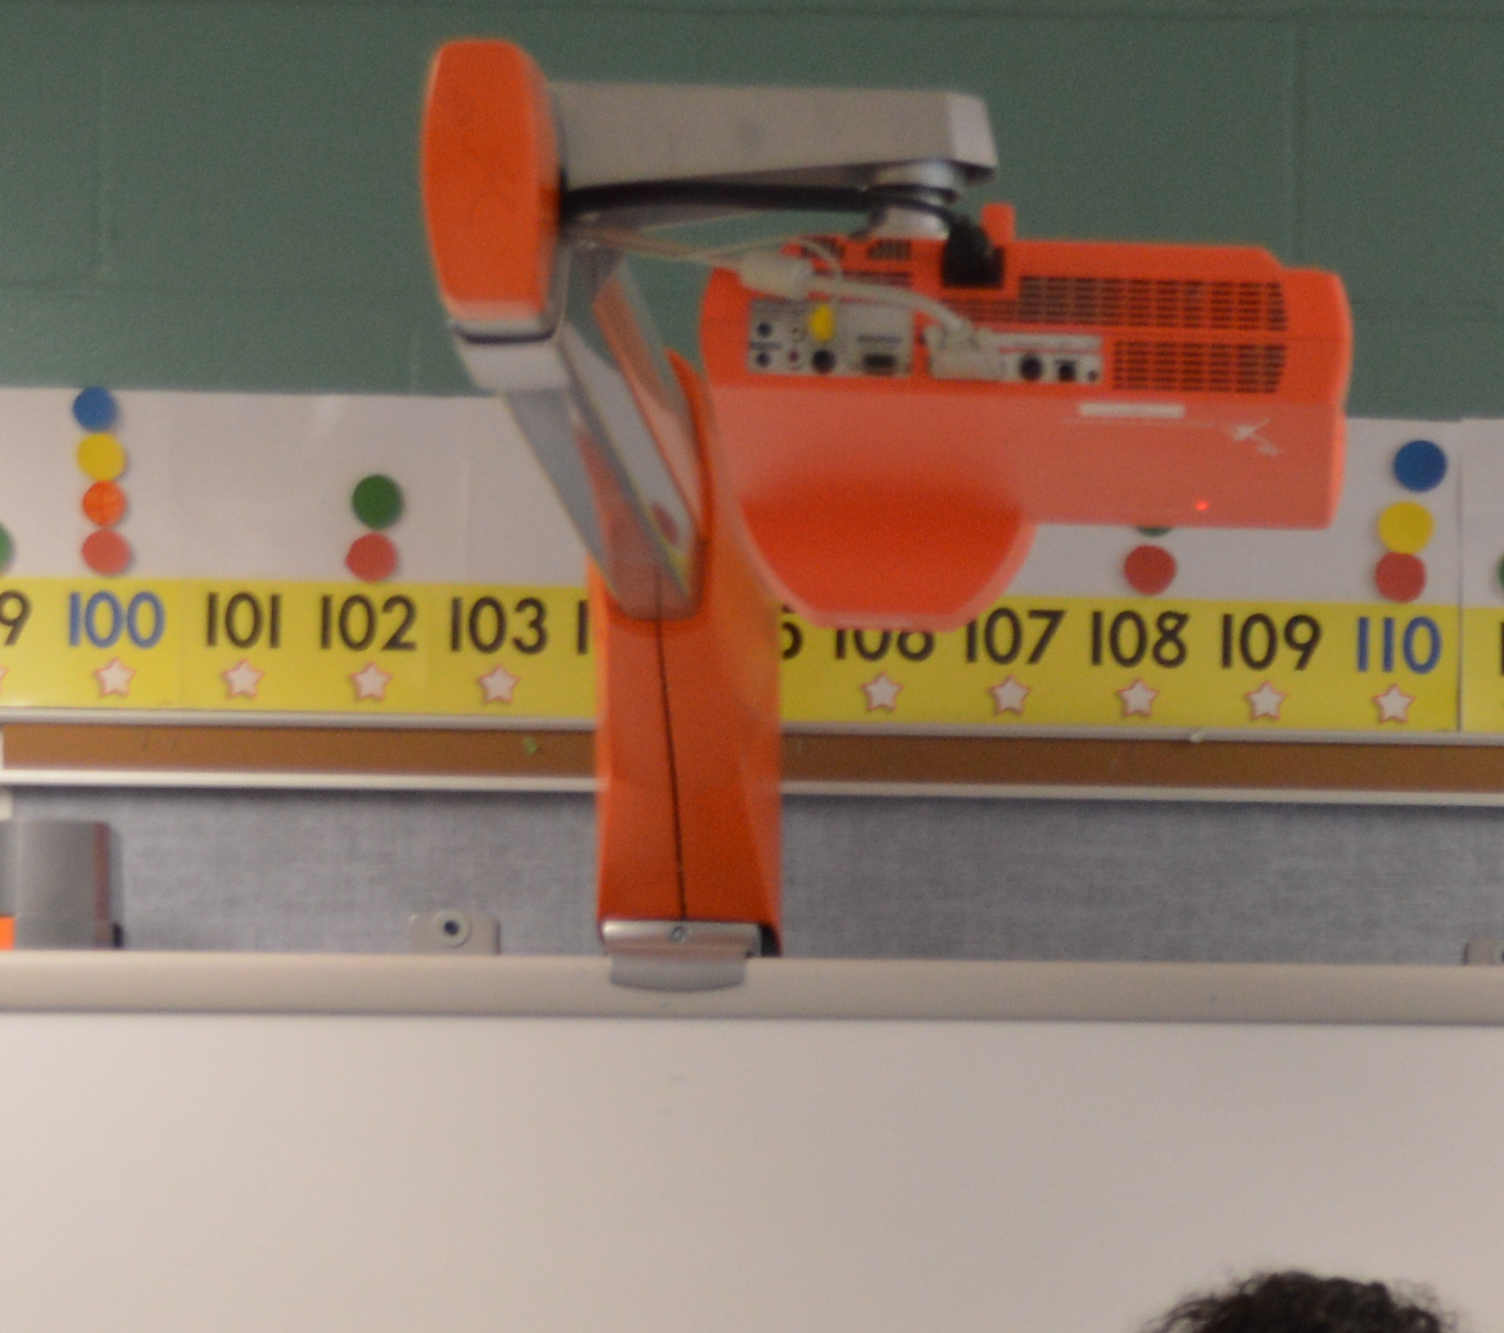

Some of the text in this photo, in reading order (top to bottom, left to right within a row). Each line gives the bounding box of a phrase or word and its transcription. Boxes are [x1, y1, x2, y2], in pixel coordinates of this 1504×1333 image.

[68, 590, 165, 649] 100
[206, 592, 281, 648] 101
[320, 594, 416, 651] 102
[451, 596, 547, 655] 103
[959, 601, 1065, 665] 107
[1091, 610, 1189, 668] 108
[1221, 613, 1321, 670] 109
[1357, 616, 1442, 674] 110
